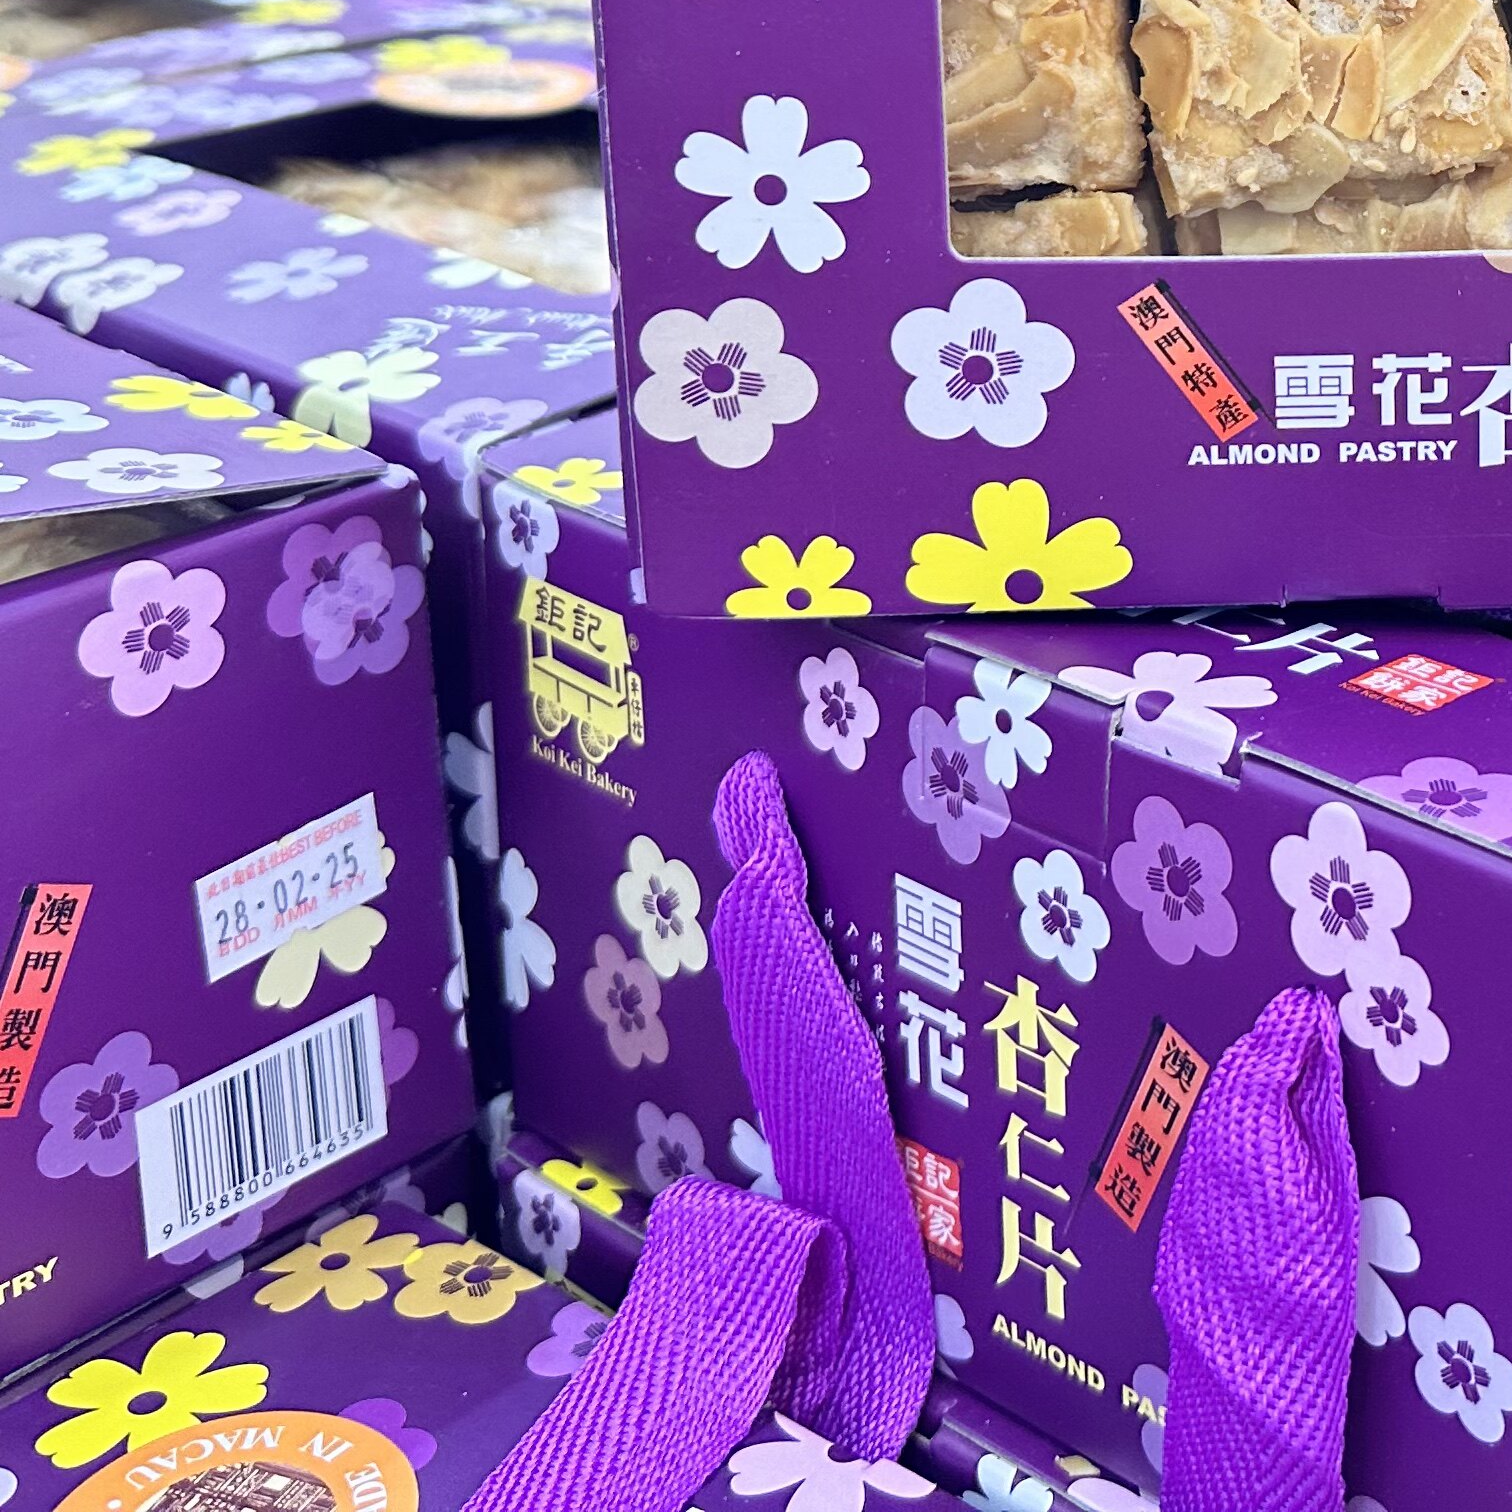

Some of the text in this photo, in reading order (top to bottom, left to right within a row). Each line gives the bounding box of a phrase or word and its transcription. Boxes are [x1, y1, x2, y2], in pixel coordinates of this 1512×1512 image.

[1129, 293, 1249, 433] 澳門特產
[1188, 439, 1458, 466] ALMOND PASTRY
[532, 735, 638, 807] Koi Kei Bakery
[894, 872, 969, 1108] 雪花
[983, 974, 1081, 1321] 杏仁片
[1104, 1035, 1198, 1219] 澳門製造
[162, 1222, 174, 1240] 9
[992, 1313, 1106, 1392] ALMOND
[125, 1426, 287, 1491] MACAU
[298, 1432, 354, 1464] IN
